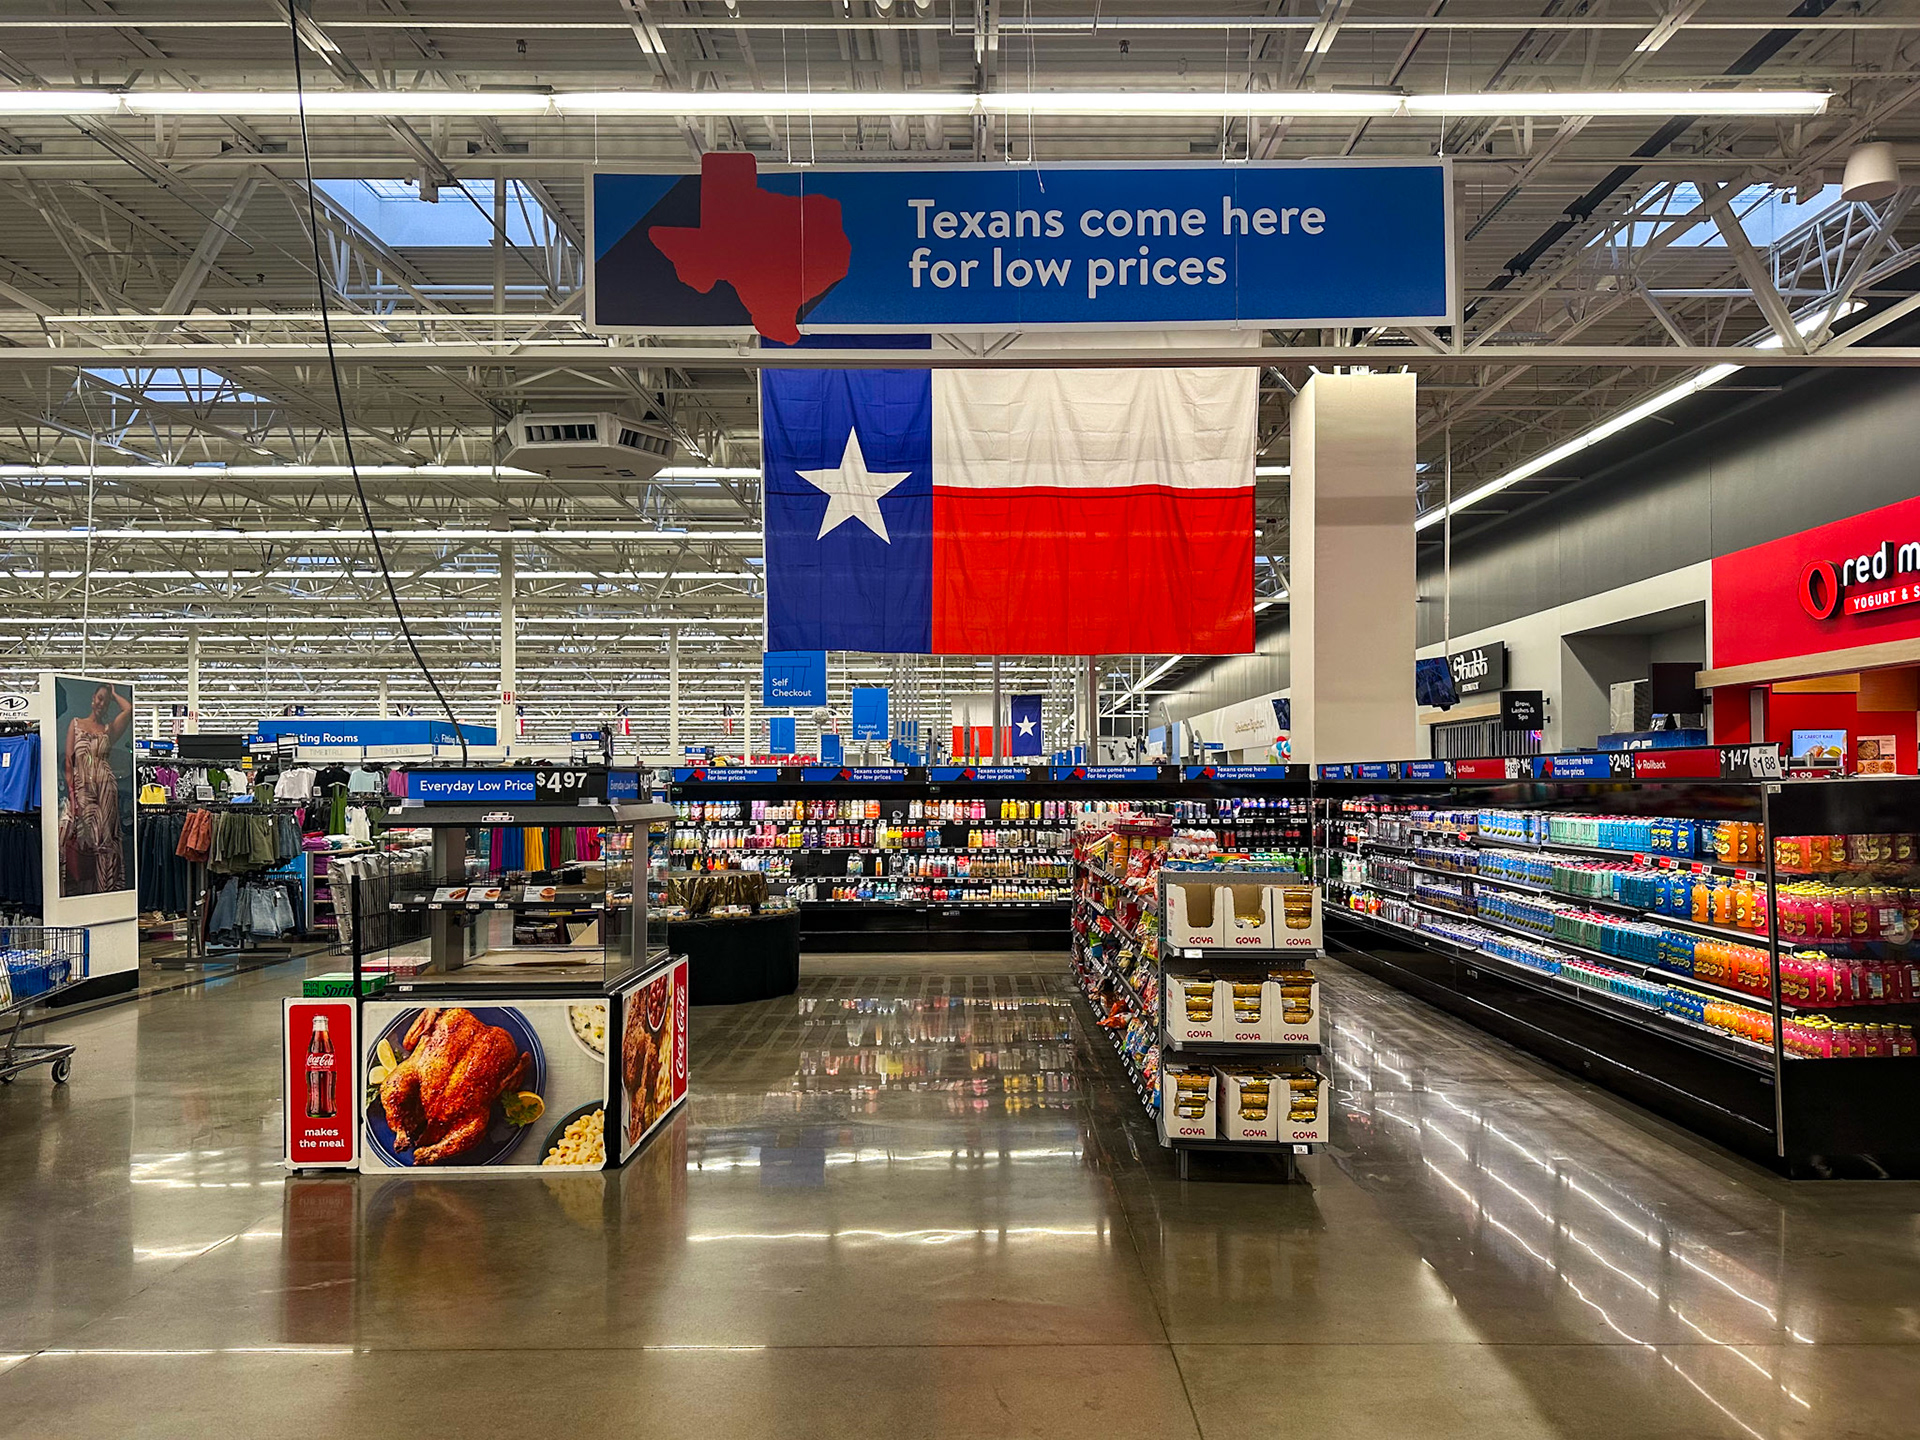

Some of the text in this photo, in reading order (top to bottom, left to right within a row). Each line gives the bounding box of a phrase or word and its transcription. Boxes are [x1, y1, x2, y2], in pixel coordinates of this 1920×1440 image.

[908, 196, 1326, 238] Texans come here
[908, 245, 1227, 299] for low prices
[1843, 541, 1887, 587] red
[1854, 590, 1896, 610] YOGURT
[1902, 588, 1908, 600] &
[772, 677, 789, 687] Self
[772, 688, 812, 698] Checkout
[323, 733, 359, 743] Rooms
[1553, 756, 1594, 766] Texans come here
[1608, 753, 1631, 772] $248
[1642, 759, 1667, 770] Rollback
[1720, 749, 1749, 771] $147
[1753, 756, 1776, 777] $188
[1554, 767, 1585, 779] for low prices
[420, 771, 588, 794] Everyday Low Price $497
[610, 779, 625, 793] Everyday
[1189, 936, 1214, 945] GOYA
[1235, 936, 1261, 945] GOYA
[1285, 938, 1312, 946] GOYA
[322, 983, 355, 997] Sprit
[676, 982, 686, 1080] Coca-Cola
[1186, 1030, 1213, 1039] GOYA
[1235, 1033, 1261, 1041] GOYA
[1283, 1033, 1309, 1042] GOYA
[306, 1053, 334, 1067] Coca-Cola
[305, 1128, 339, 1136] makes
[1179, 1127, 1206, 1136] GOYA
[1242, 1129, 1268, 1138] GOYA
[1292, 1131, 1319, 1140] GOYA
[299, 1139, 345, 1148] the meal
